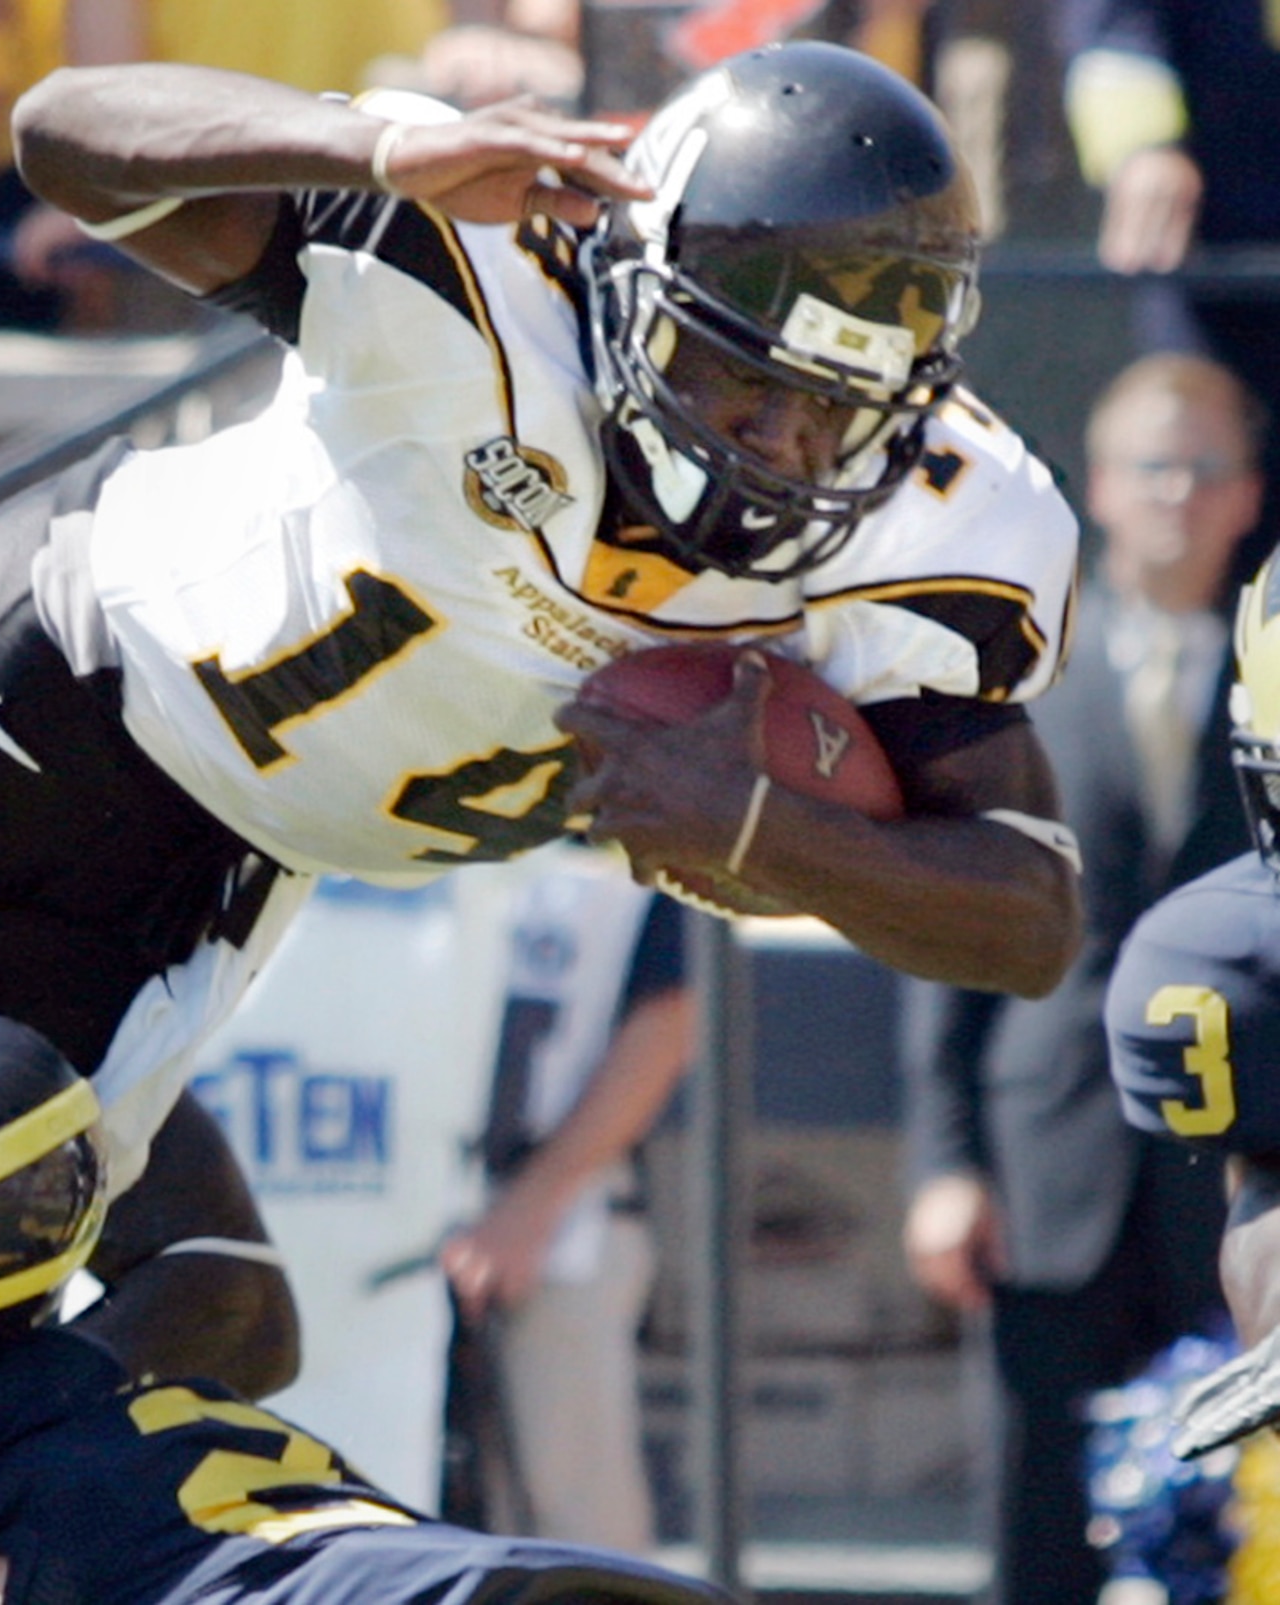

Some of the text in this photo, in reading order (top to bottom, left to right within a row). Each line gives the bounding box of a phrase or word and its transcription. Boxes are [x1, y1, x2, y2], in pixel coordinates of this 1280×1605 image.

[185, 567, 594, 866] 14
[523, 615, 596, 670] State
[1145, 984, 1236, 1137] 3
